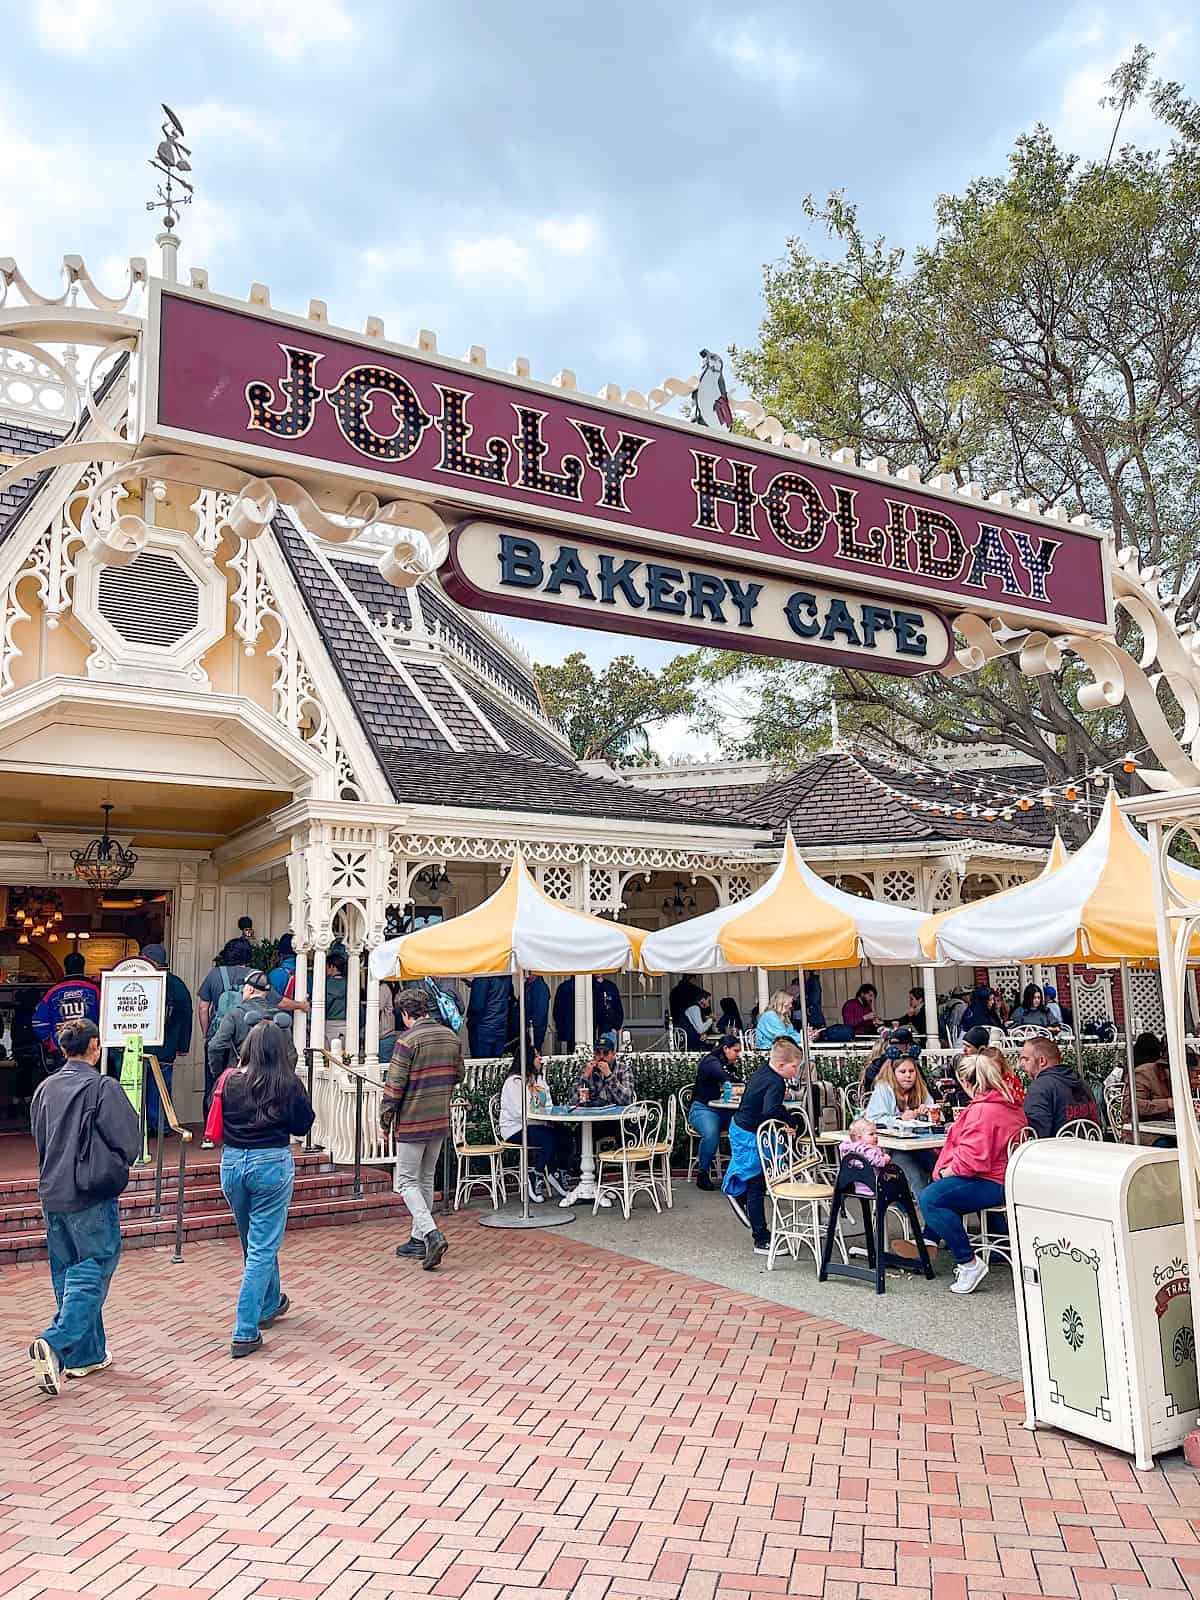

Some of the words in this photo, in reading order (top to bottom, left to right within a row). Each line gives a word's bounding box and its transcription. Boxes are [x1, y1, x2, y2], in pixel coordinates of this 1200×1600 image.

[245, 343, 656, 513] JOLLY
[688, 448, 1062, 603] HOLIDAY
[497, 533, 763, 627] BAKERY
[782, 591, 928, 656] CAFE
[1166, 1281, 1189, 1297] TRAS
